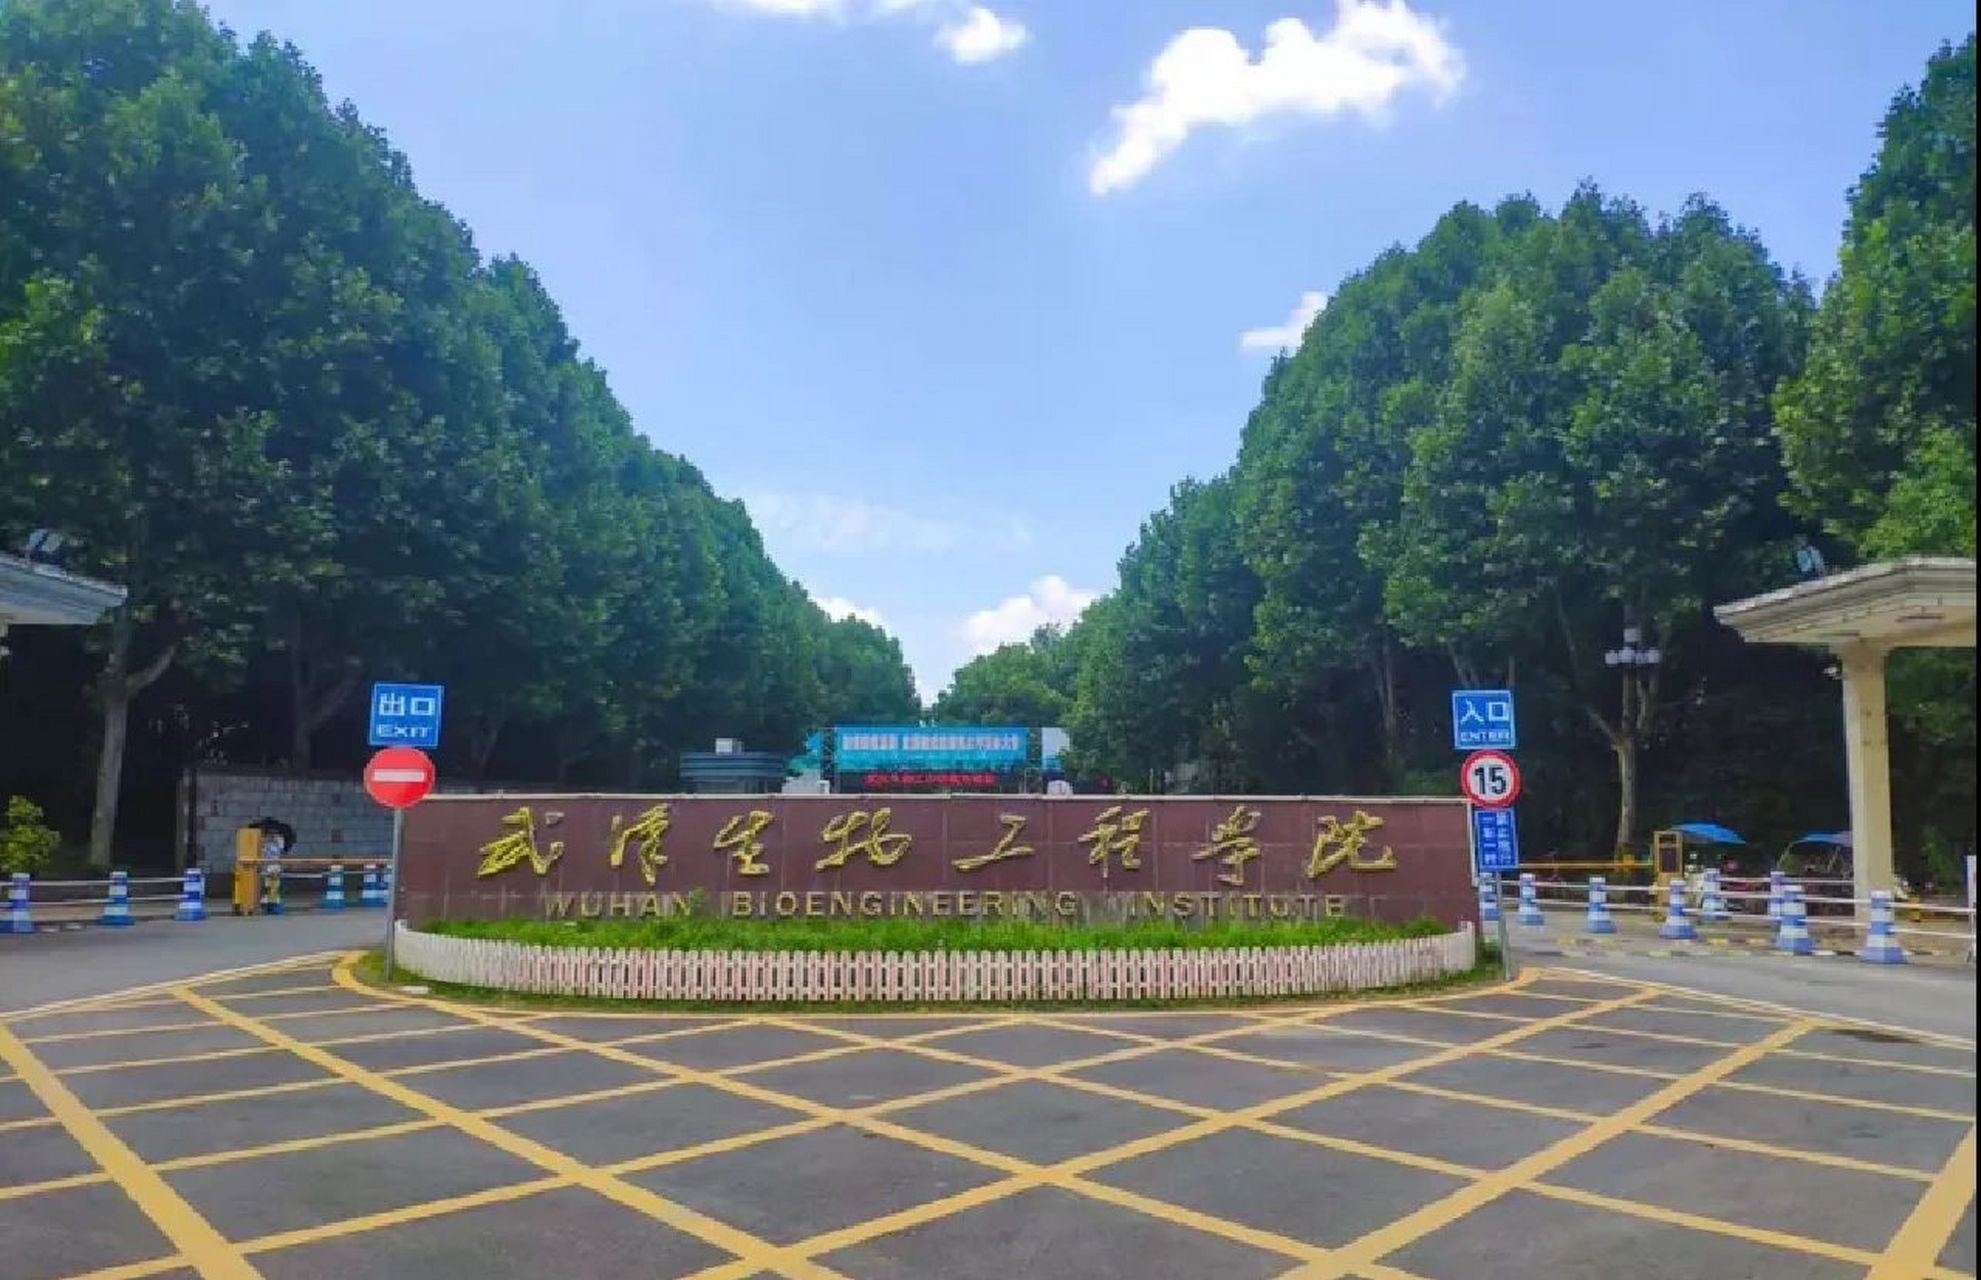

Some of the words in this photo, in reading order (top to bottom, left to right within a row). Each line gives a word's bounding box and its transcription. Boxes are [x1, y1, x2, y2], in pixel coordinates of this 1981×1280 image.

[378, 692, 436, 716] 出口
[1460, 698, 1510, 724] 入口
[376, 724, 433, 738] EXIT
[1474, 767, 1507, 795] 15
[545, 891, 694, 918] WUHAN
[731, 891, 1076, 917] BIOENGINEERING
[1130, 891, 1346, 917] INSTITUTE
